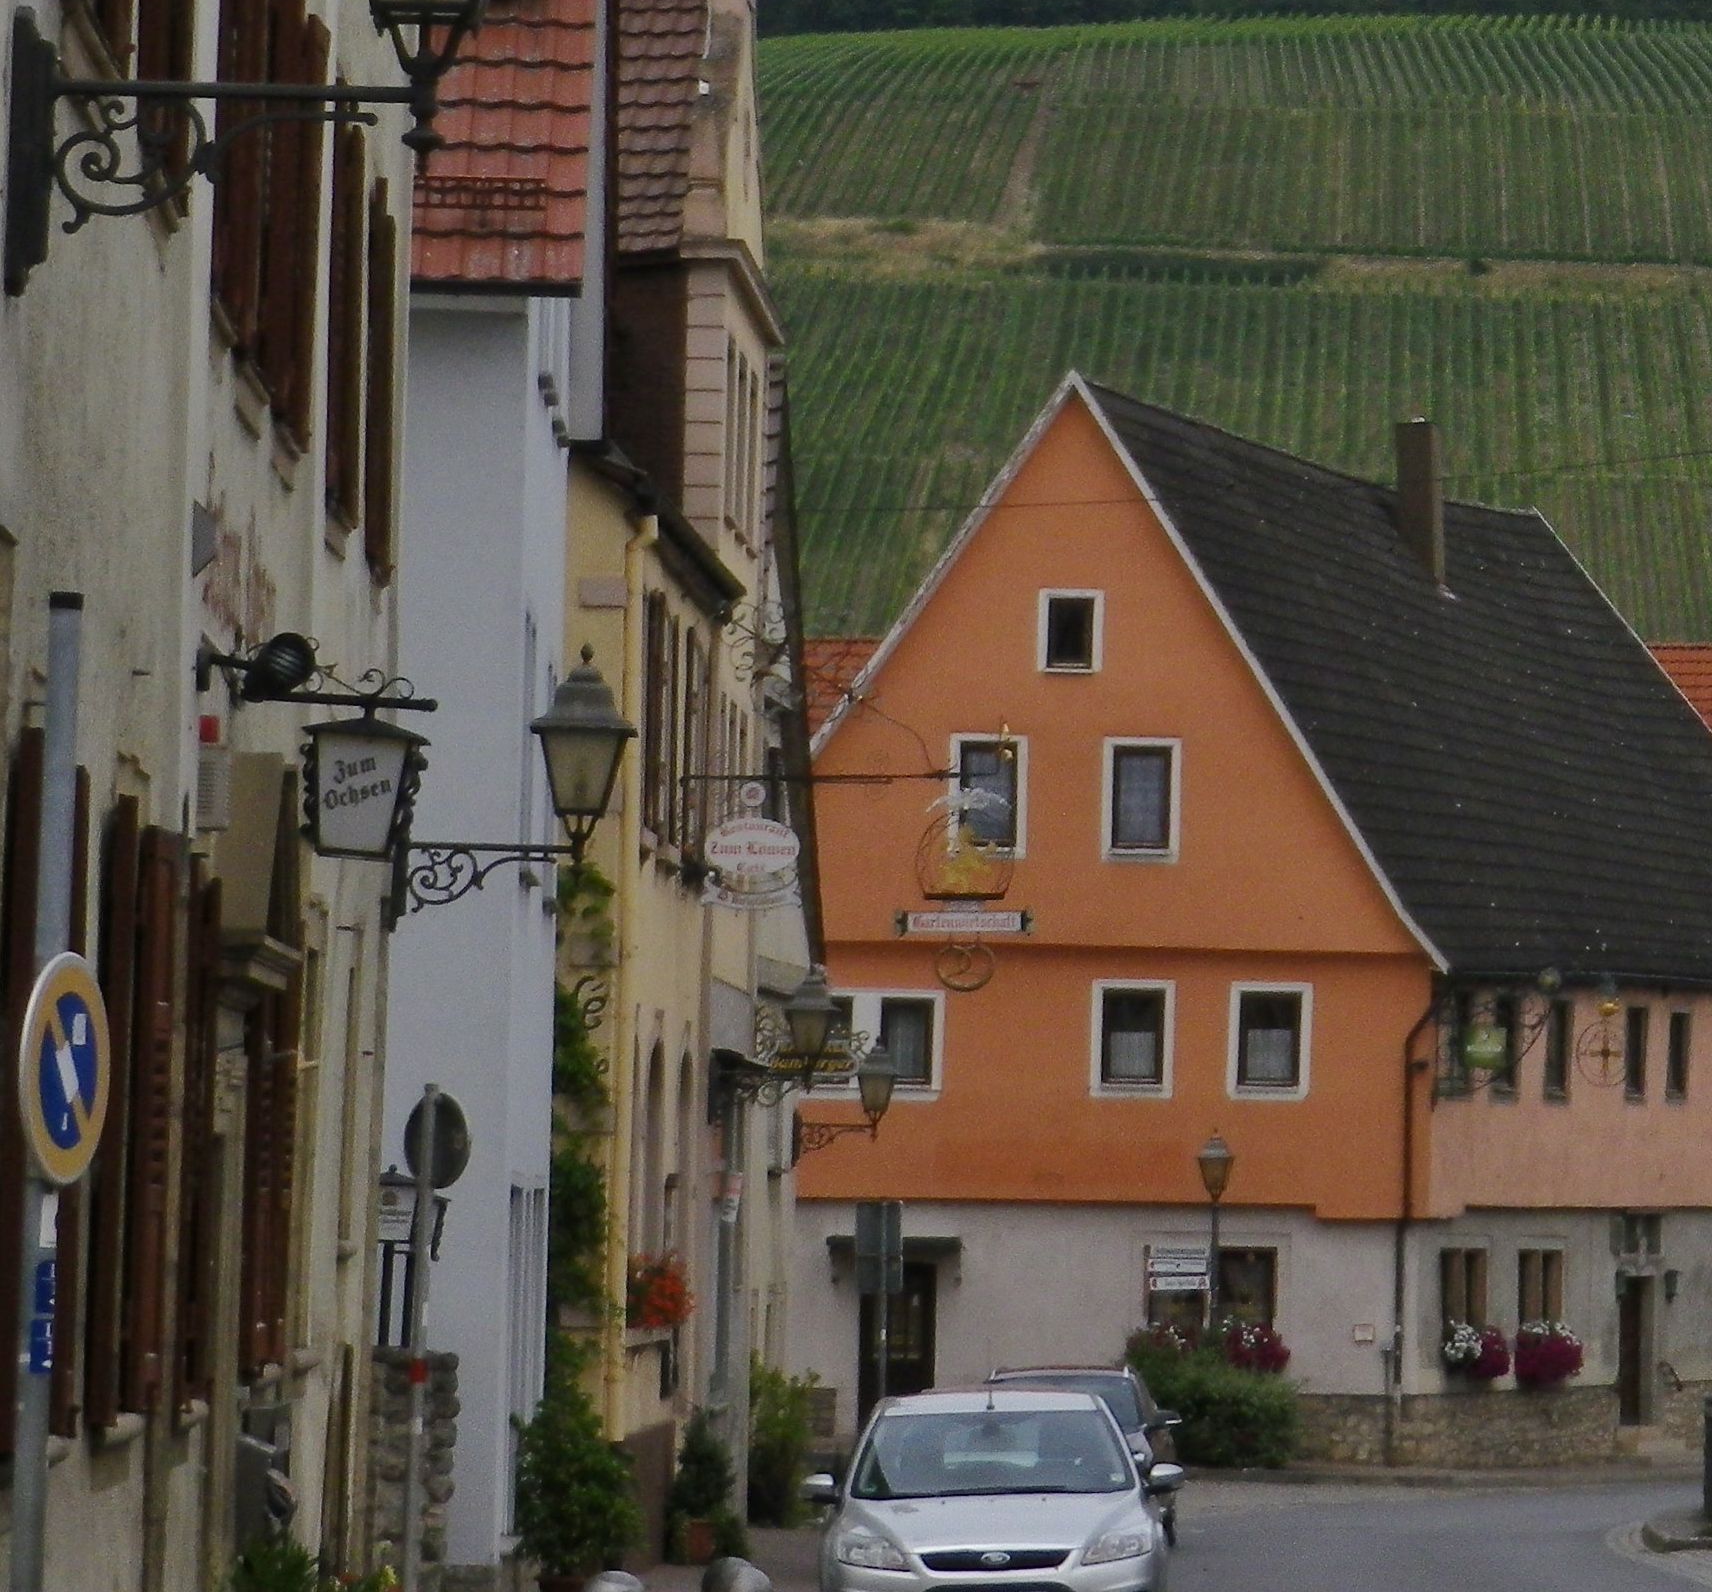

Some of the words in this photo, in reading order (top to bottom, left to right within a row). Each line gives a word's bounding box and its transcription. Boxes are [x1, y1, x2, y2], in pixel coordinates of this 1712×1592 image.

[333, 757, 377, 784] Zum
[323, 779, 392, 810] Ochsen
[710, 840, 742, 855] Zum
